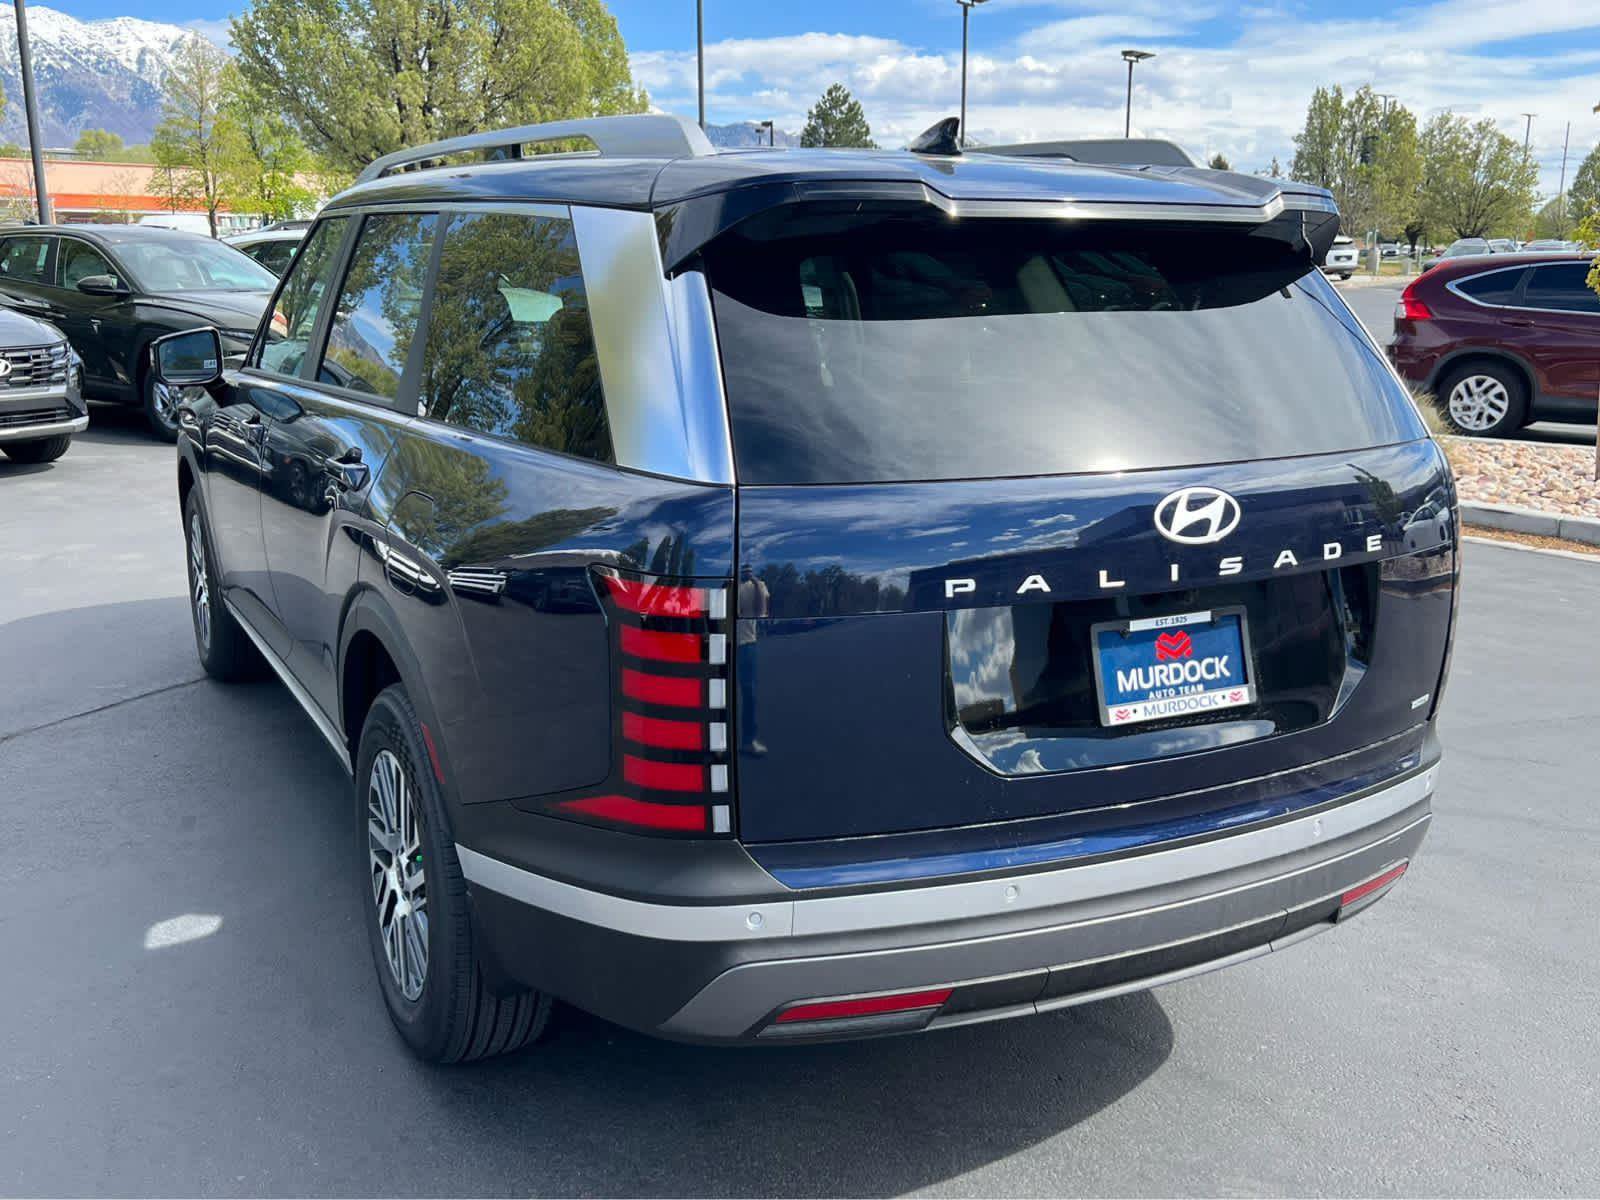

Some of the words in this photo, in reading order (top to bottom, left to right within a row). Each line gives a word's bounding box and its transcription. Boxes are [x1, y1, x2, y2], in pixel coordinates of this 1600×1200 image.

[945, 534, 1383, 598] PALISADE
[1117, 655, 1231, 693] MURDOCK
[1143, 695, 1218, 718] MURDOCK
[1148, 689, 1175, 700] AUTO
[1180, 684, 1204, 696] TEAM
